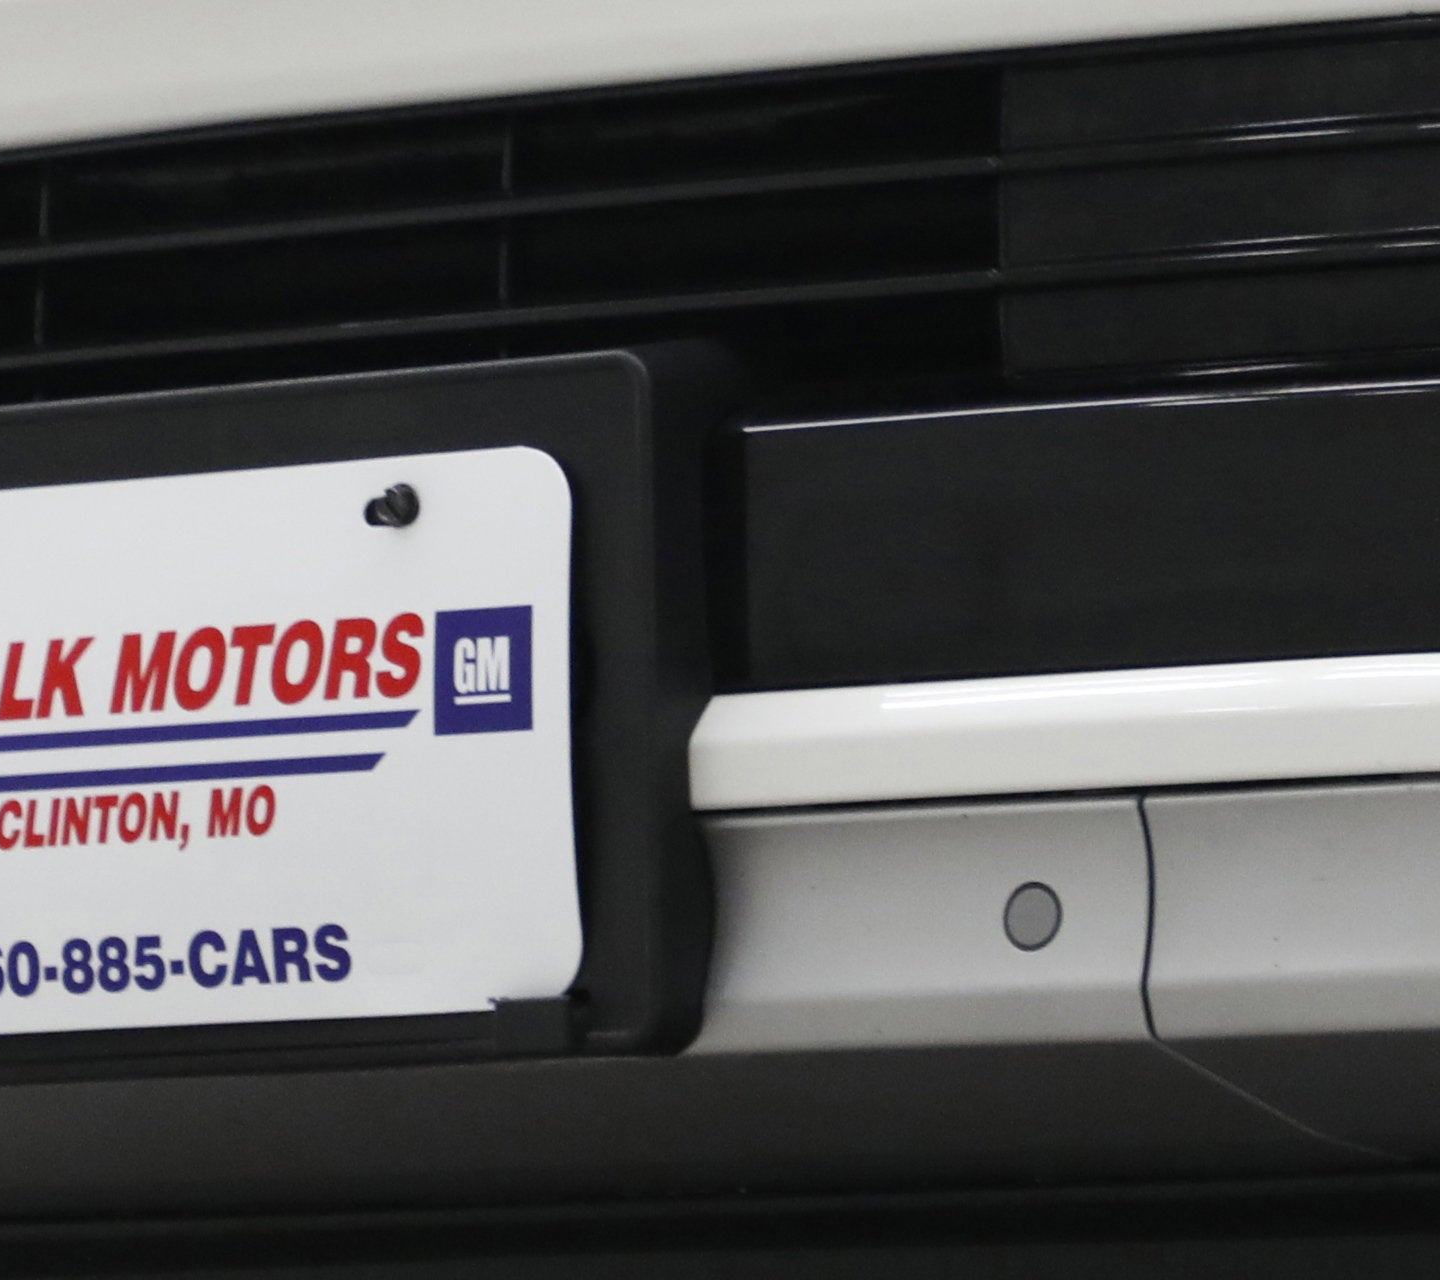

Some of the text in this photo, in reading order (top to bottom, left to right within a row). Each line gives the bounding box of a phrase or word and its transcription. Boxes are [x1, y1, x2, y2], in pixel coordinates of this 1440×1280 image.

[109, 611, 426, 715] MOTORS
[452, 635, 511, 696] GM
[207, 784, 278, 838] MO
